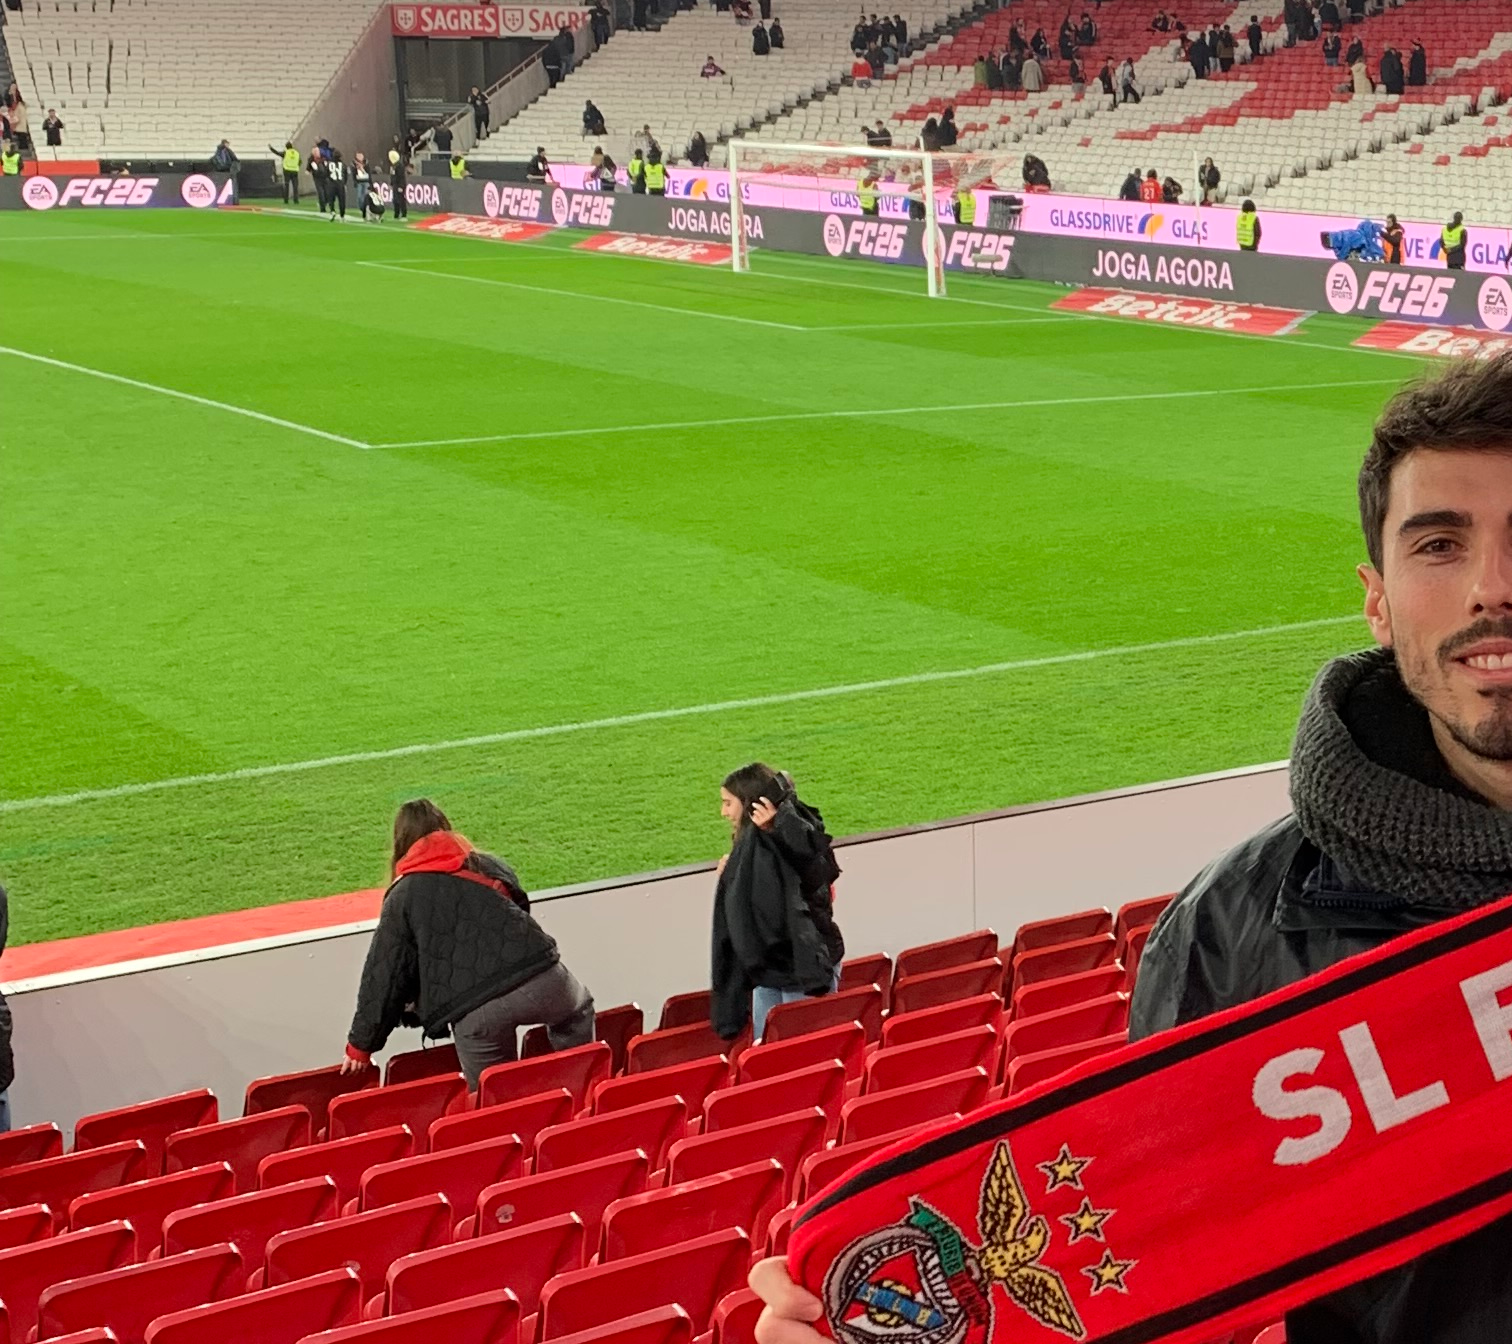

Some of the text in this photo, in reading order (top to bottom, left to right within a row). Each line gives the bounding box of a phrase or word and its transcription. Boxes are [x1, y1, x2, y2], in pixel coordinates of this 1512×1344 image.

[421, 7, 497, 33] SAGRES
[528, 8, 587, 33] SAGR
[30, 184, 51, 194] EA
[59, 178, 159, 205] FC26
[189, 183, 208, 193] EA
[405, 183, 440, 205] GORA
[499, 187, 542, 218] FC26
[568, 194, 615, 226] FC26
[668, 207, 708, 233] JOGA
[828, 224, 841, 238] EA
[1050, 209, 1134, 233] GLASSDRIVE
[845, 221, 908, 258] FC26
[1092, 249, 1234, 290] JOGA AGORA
[1332, 273, 1351, 290] EA
[1331, 290, 1352, 300] SPORTS
[1357, 270, 1456, 317] FC26
[1485, 288, 1507, 307] EA
[1087, 294, 1252, 329] Betclic
[1483, 305, 1508, 316] SPORTS
[1251, 1021, 1450, 1167] SL
